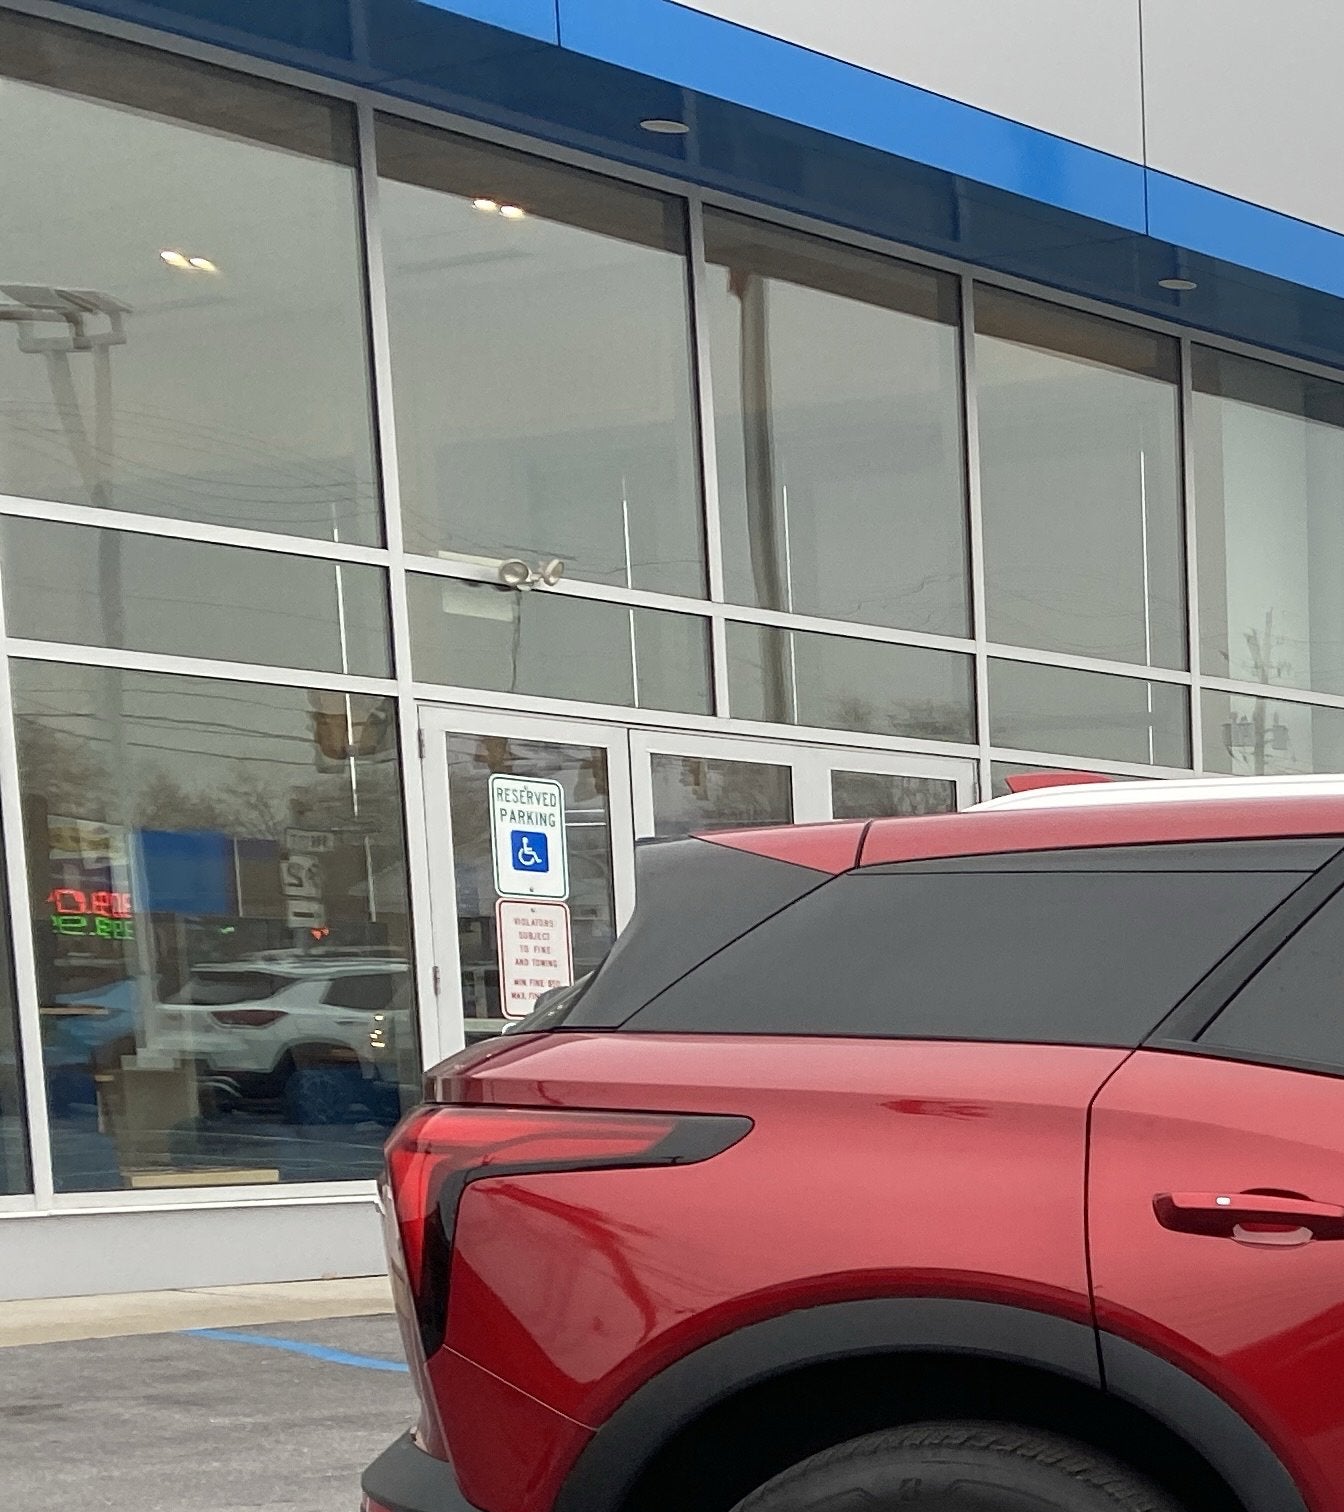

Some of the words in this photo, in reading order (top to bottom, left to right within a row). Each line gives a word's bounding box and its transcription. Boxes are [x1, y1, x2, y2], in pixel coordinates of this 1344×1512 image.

[497, 787, 557, 807] RESERVED
[500, 807, 556, 827] PARKING
[513, 917, 554, 929] VIOLATORS
[518, 931, 551, 941] SUBJECT
[519, 944, 530, 953] TO
[533, 945, 551, 955] FINE
[514, 957, 529, 966] AND
[531, 958, 558, 969] TOWING
